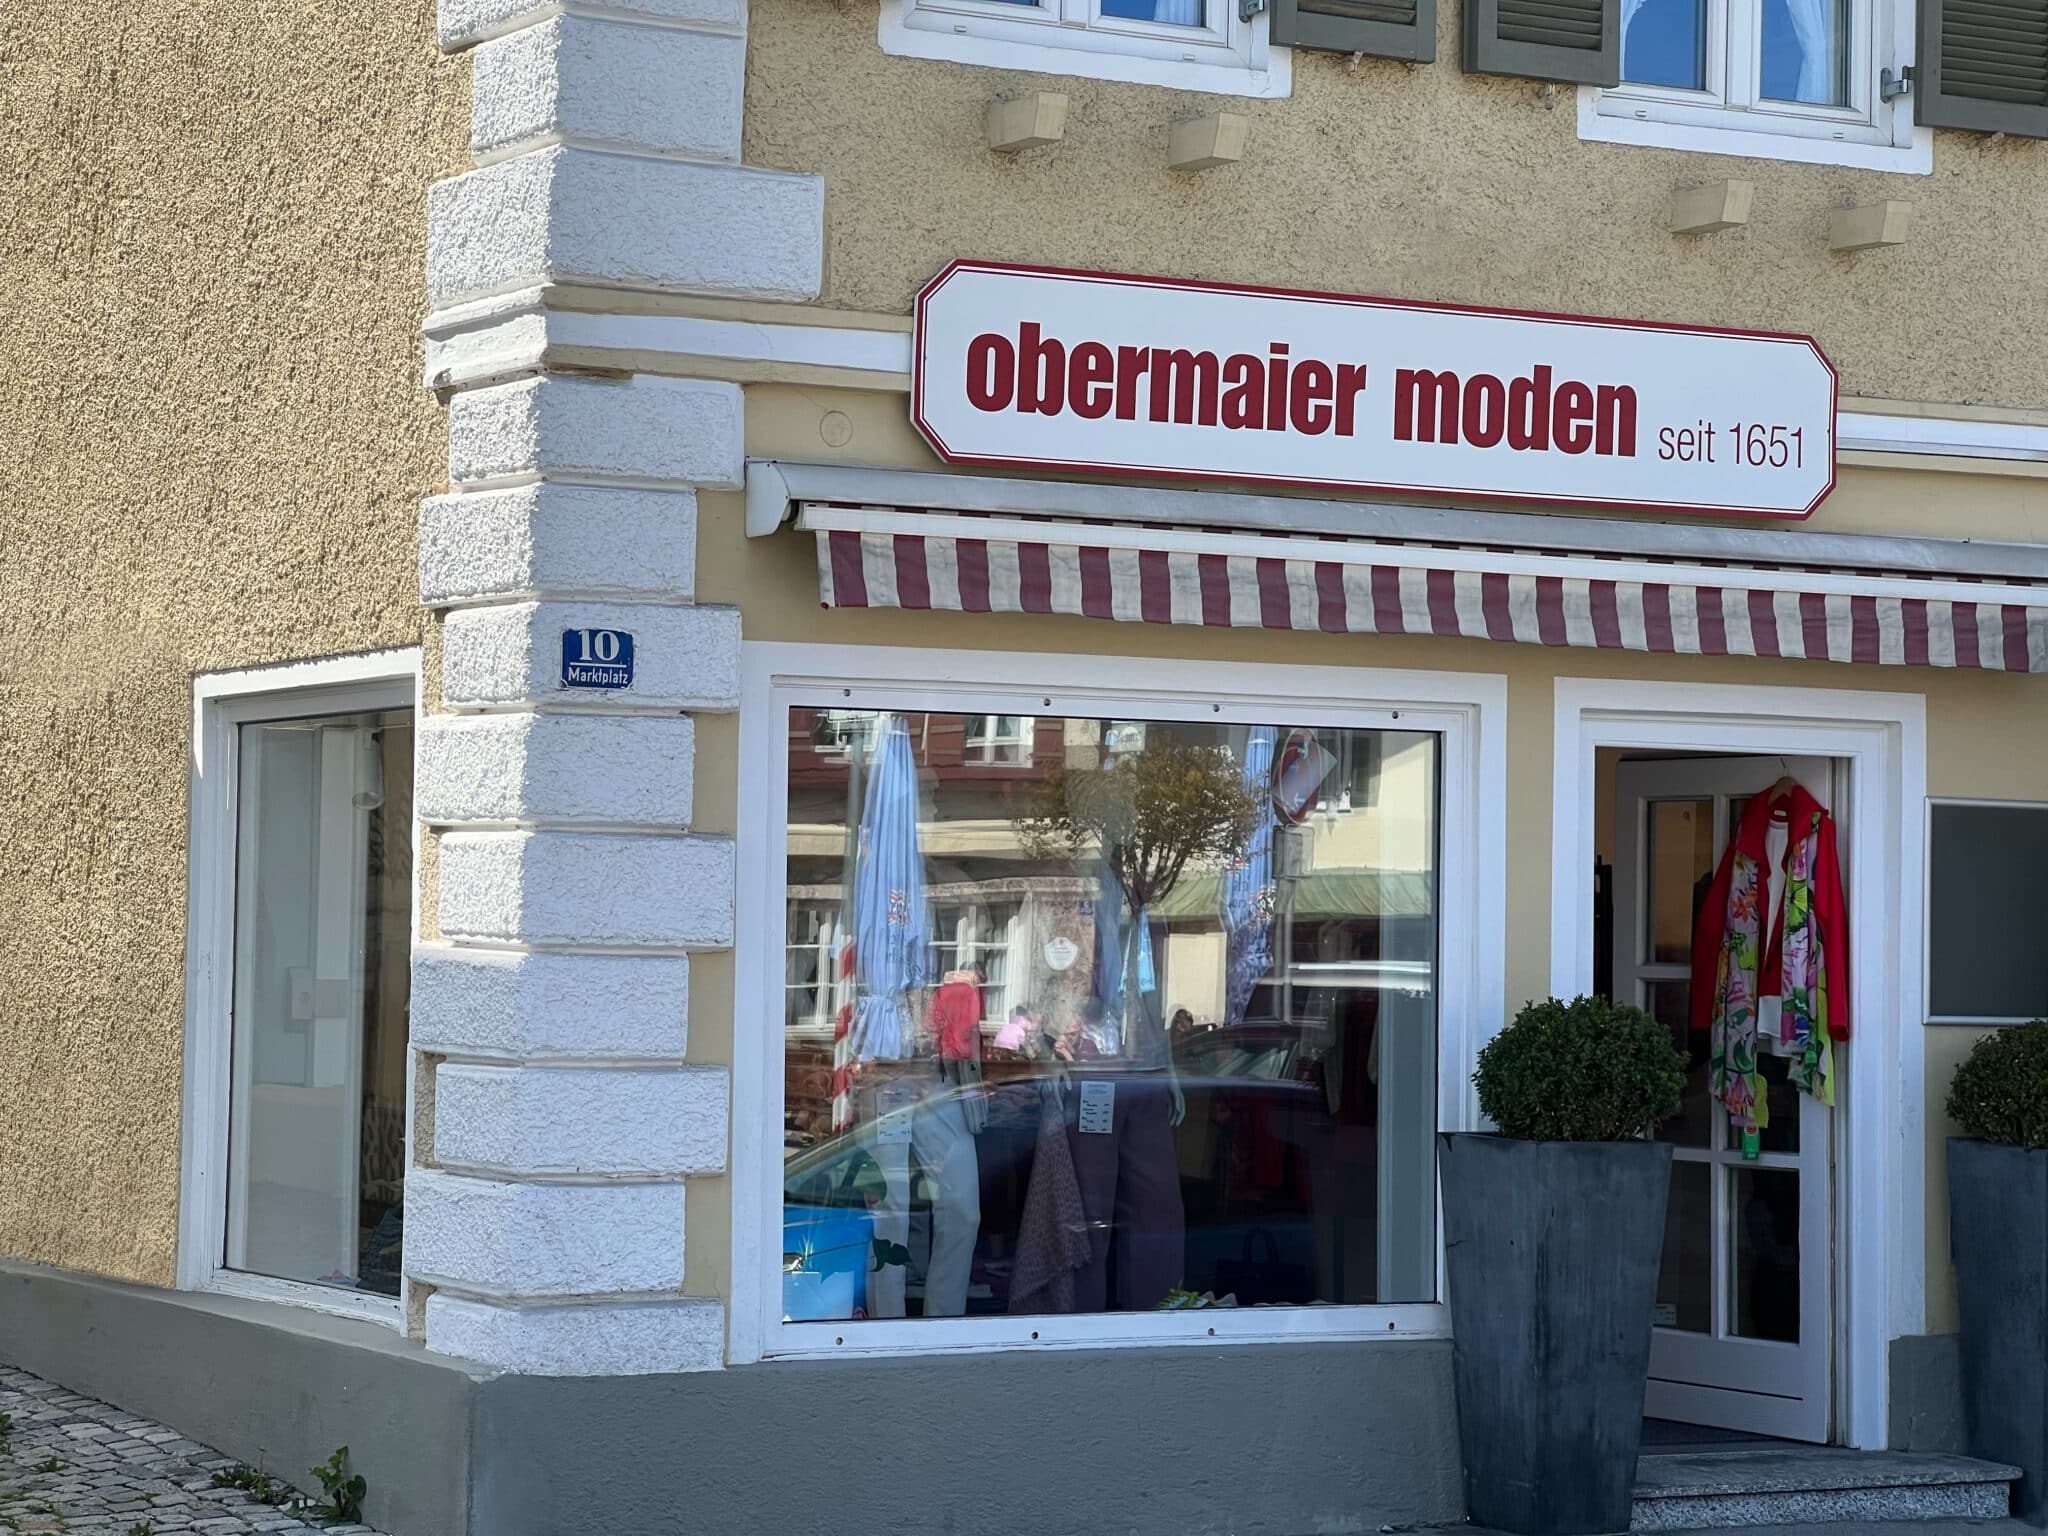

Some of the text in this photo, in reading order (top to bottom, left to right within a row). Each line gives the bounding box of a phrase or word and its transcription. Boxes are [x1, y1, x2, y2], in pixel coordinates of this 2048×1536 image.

[966, 321, 1803, 469] obermaier moden seit 1651
[578, 629, 620, 661] 10
[568, 667, 628, 685] Marktplatz
